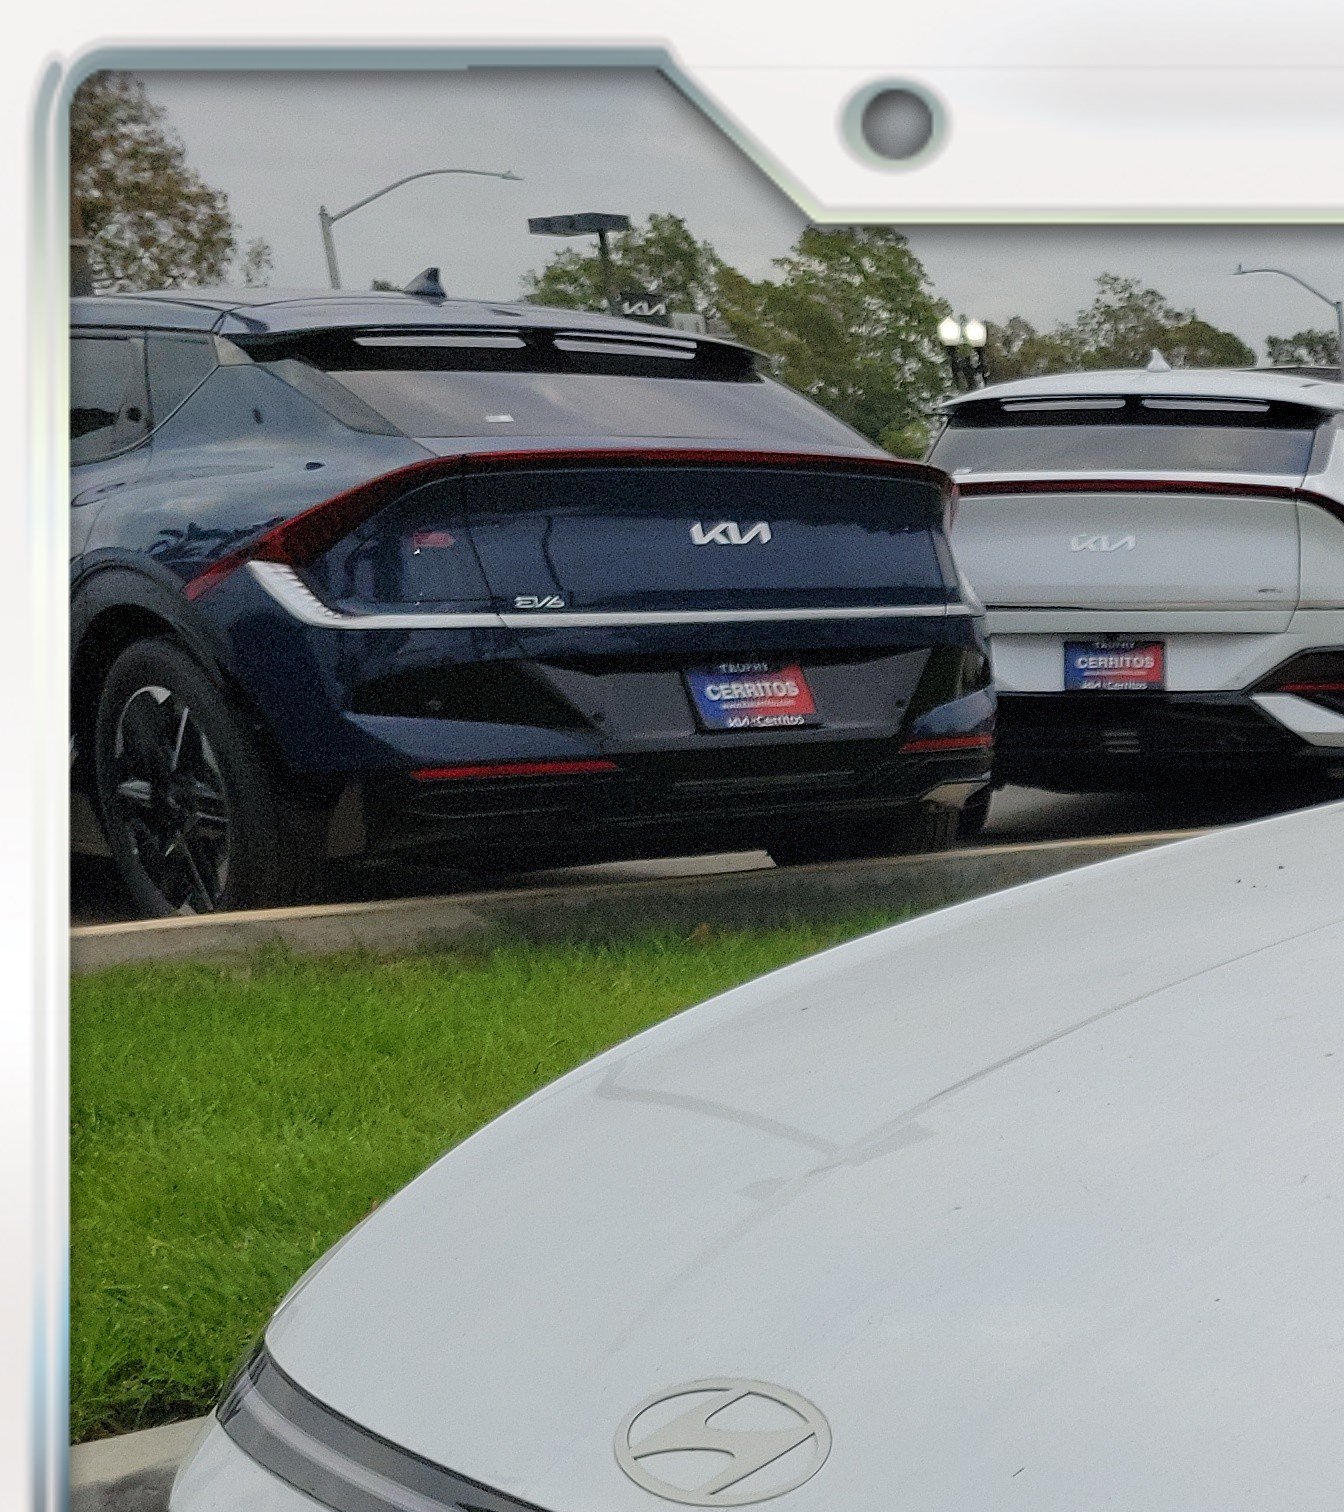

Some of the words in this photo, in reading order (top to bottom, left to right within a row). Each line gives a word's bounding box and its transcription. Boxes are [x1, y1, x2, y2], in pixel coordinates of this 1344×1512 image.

[690, 521, 773, 546] KIA
[513, 595, 565, 609] EV6
[1075, 655, 1155, 669] CERRITOS
[704, 681, 800, 701] CERRITOS
